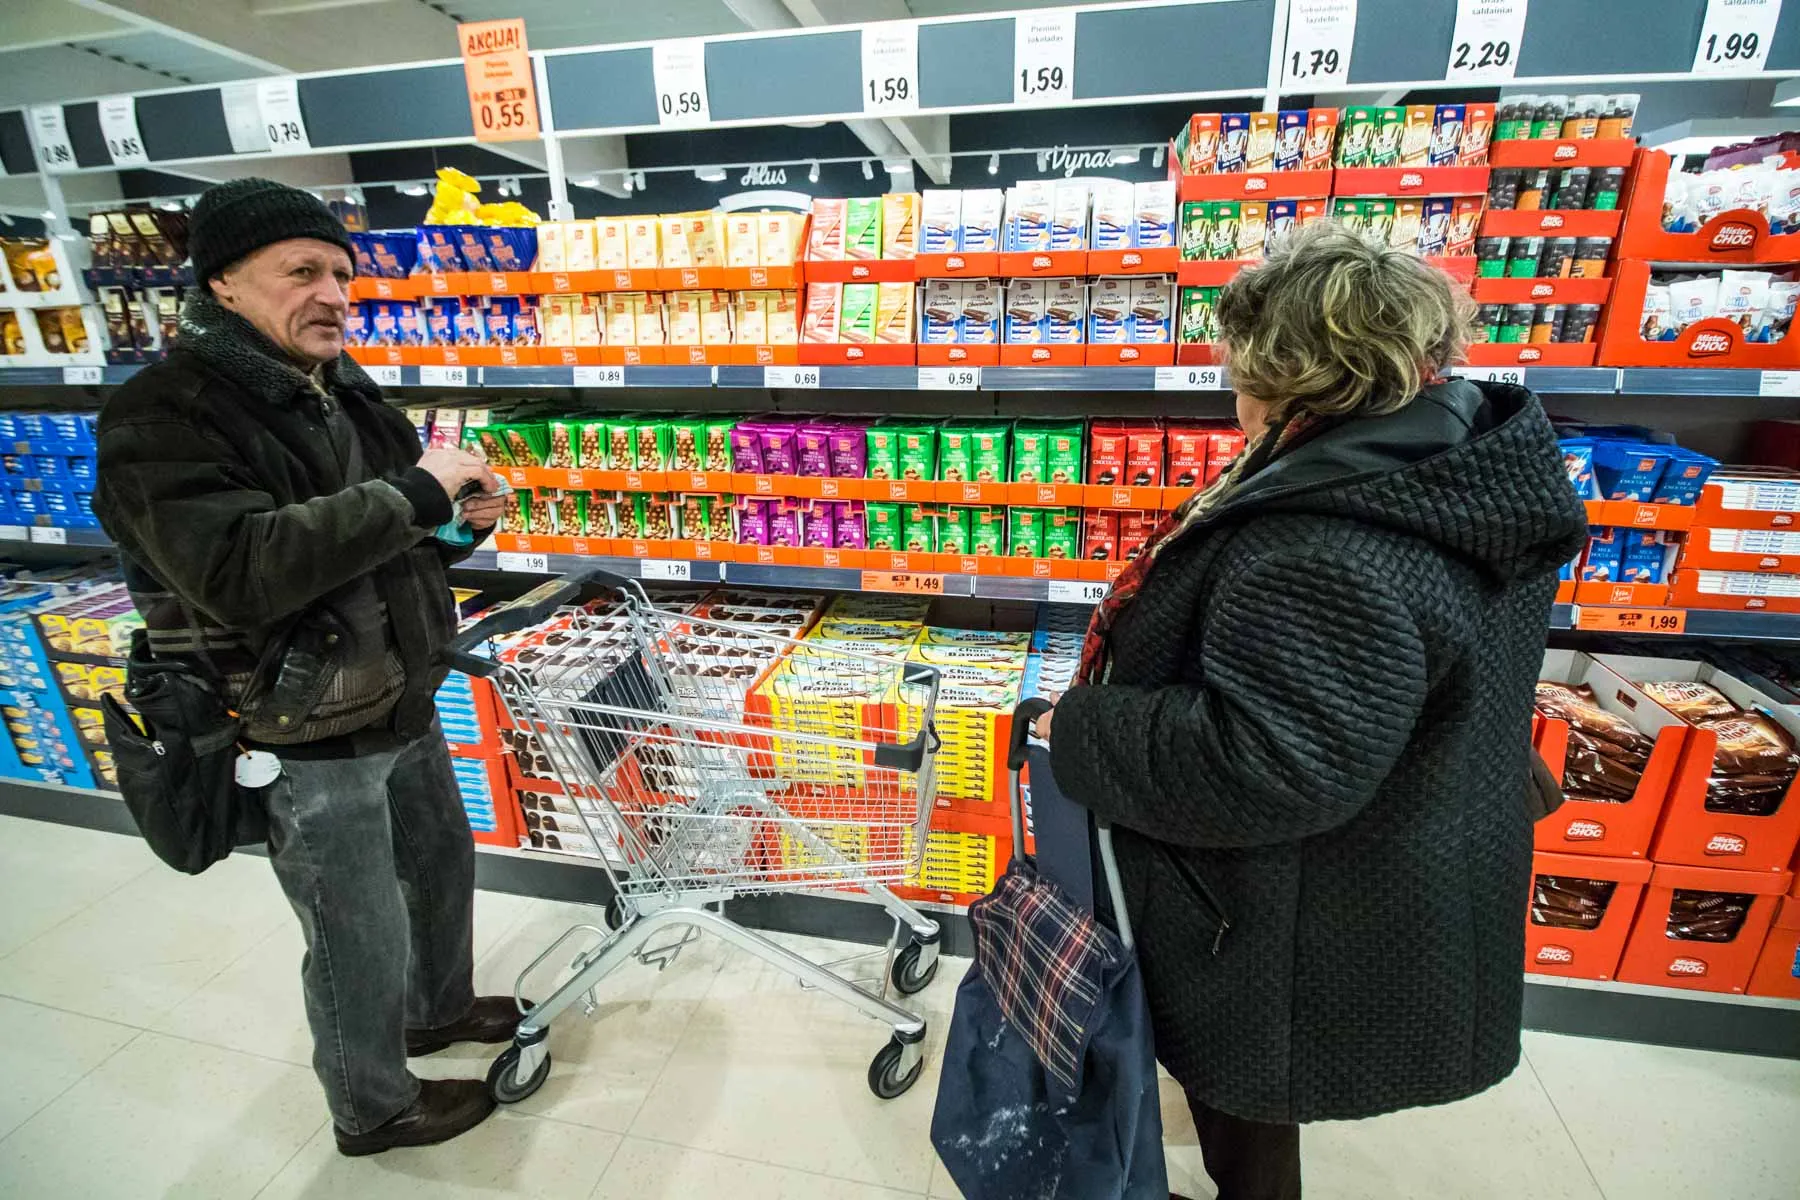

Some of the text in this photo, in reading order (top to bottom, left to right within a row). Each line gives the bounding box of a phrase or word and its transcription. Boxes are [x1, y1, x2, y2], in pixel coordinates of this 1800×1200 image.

[467, 27, 520, 50] AKCIJA!
[1705, 32, 1759, 63] 1,99
[1453, 41, 1511, 71] 2,29
[1292, 49, 1340, 79] 1,79
[1021, 66, 1064, 95] 1,59
[869, 77, 909, 104] 1,59
[662, 92, 701, 117] 0,59
[481, 103, 524, 130] 0,55
[268, 121, 301, 145] 0,79
[1045, 144, 1116, 178] Vynas
[740, 162, 787, 188] Alus
[1720, 227, 1750, 236] Mister
[1713, 234, 1752, 245] CHOC
[1697, 334, 1726, 342] Mister
[1691, 341, 1729, 352] CHOC
[599, 371, 620, 384] 0,89
[794, 373, 817, 385] 0,69
[948, 373, 973, 385] 0,59
[1189, 371, 1216, 385] 0,59
[526, 557, 544, 569] 1,99
[667, 564, 687, 576] 1,79
[915, 577, 939, 590] 1,49
[1084, 587, 1104, 599] 1,19
[1649, 616, 1678, 632] 1,99
[1567, 828, 1602, 837] CHOC
[1707, 842, 1743, 852] CHOC
[1537, 953, 1571, 961] CHOC
[1669, 964, 1705, 974] CHOC
